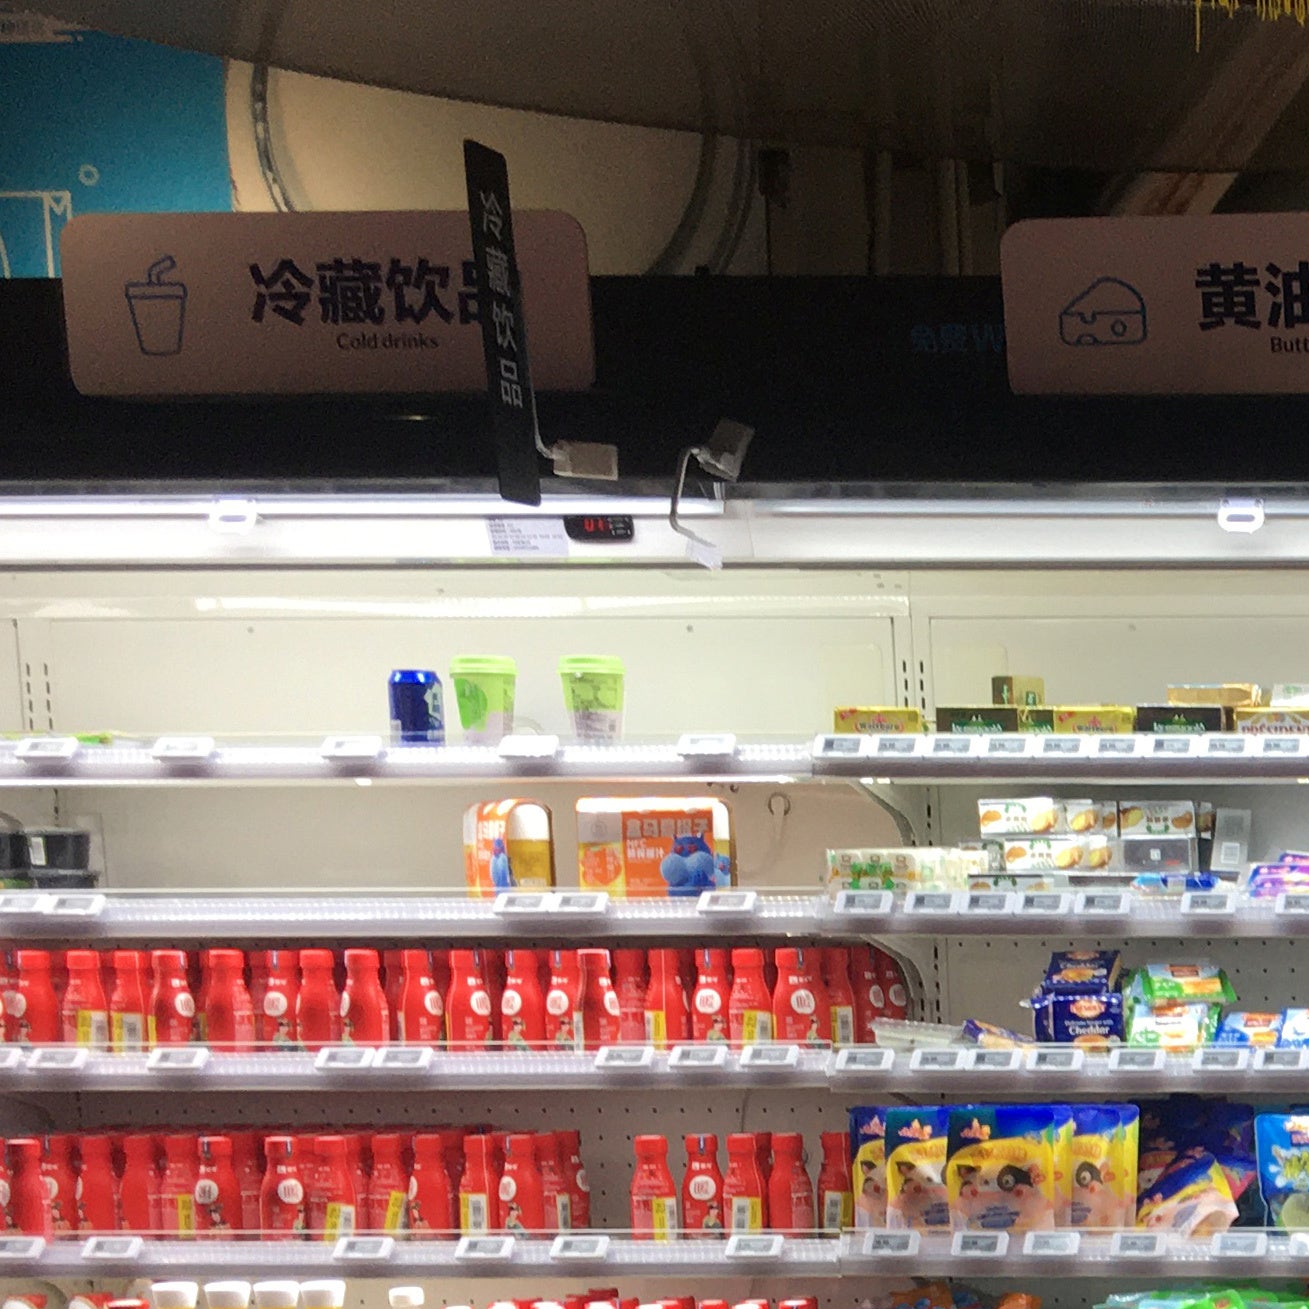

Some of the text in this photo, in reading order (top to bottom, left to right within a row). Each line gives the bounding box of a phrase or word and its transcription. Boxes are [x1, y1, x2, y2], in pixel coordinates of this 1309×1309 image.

[480, 190, 524, 408] 冷藏饮品
[337, 332, 439, 351] Cold drinks
[1068, 1024, 1109, 1036] Cheddar
